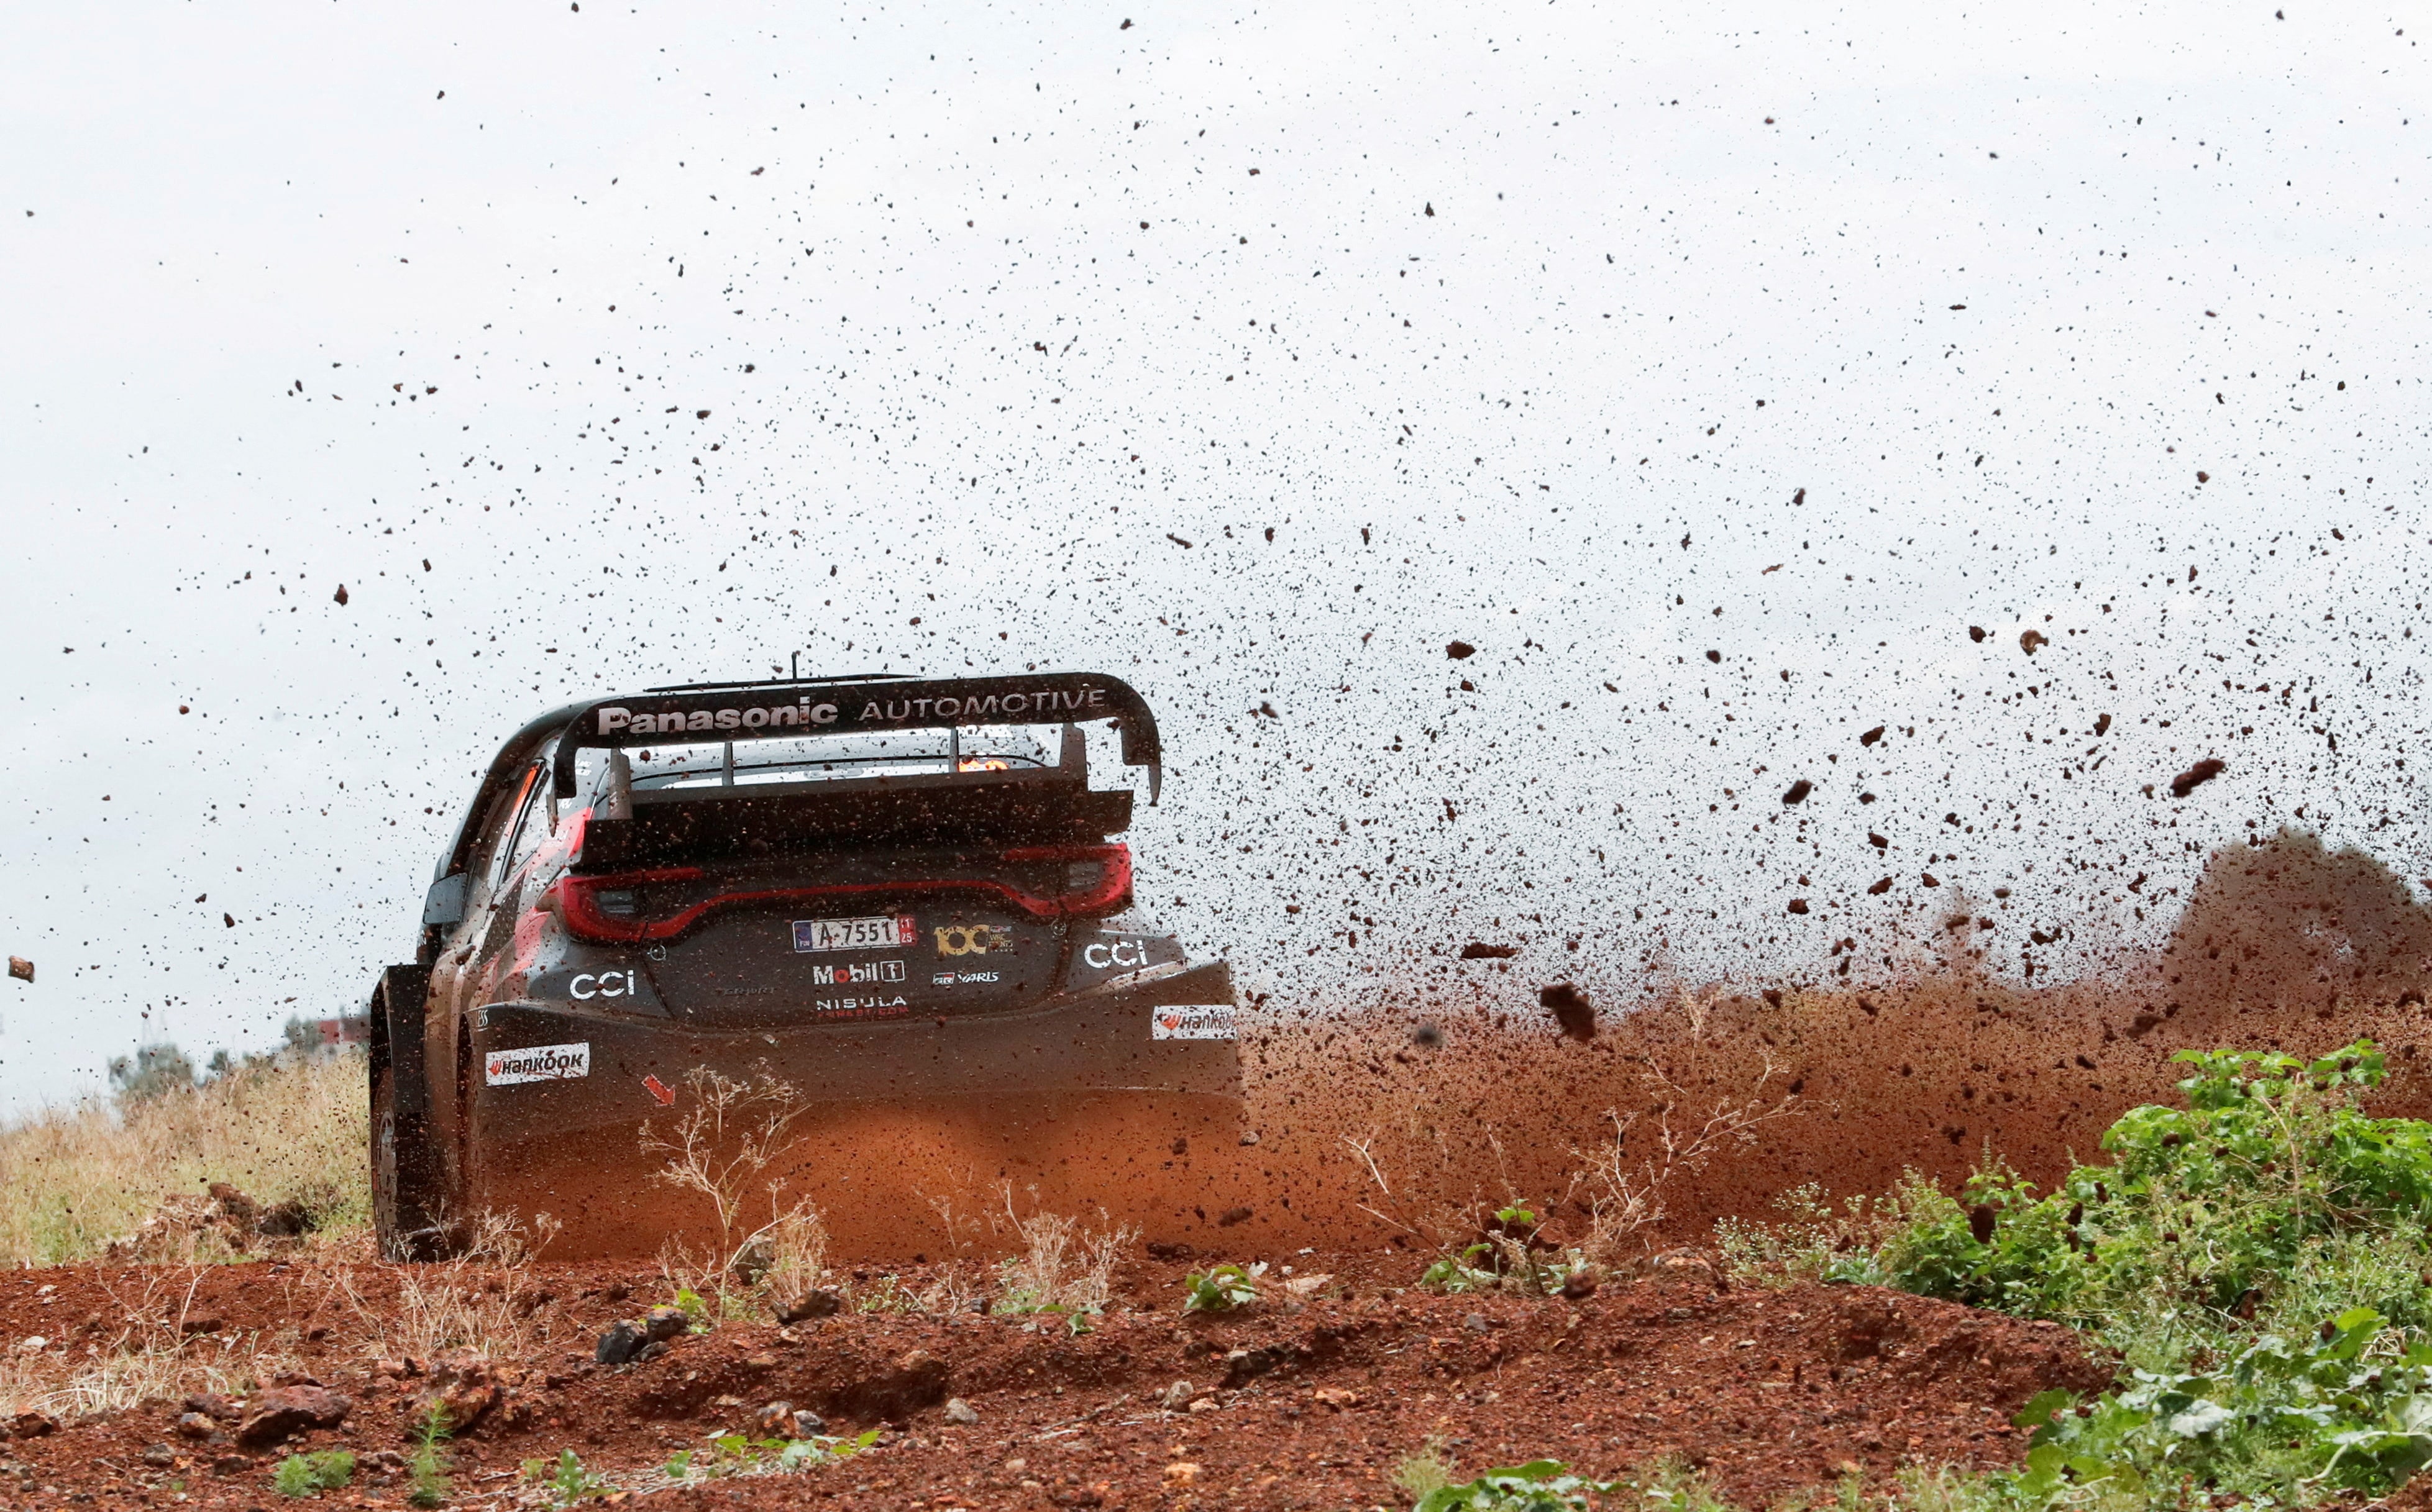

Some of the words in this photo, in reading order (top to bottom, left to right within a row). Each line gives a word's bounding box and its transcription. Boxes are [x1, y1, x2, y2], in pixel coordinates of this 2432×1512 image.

[598, 696, 839, 736] Panasonic
[858, 688, 1106, 721] AUTOMOTIVE
[819, 921, 892, 946] A-7551
[901, 932, 912, 943] 25
[813, 962, 878, 985] Mobil
[816, 996, 907, 1011] NISULA
[1180, 1013, 1235, 1029] Hankoo
